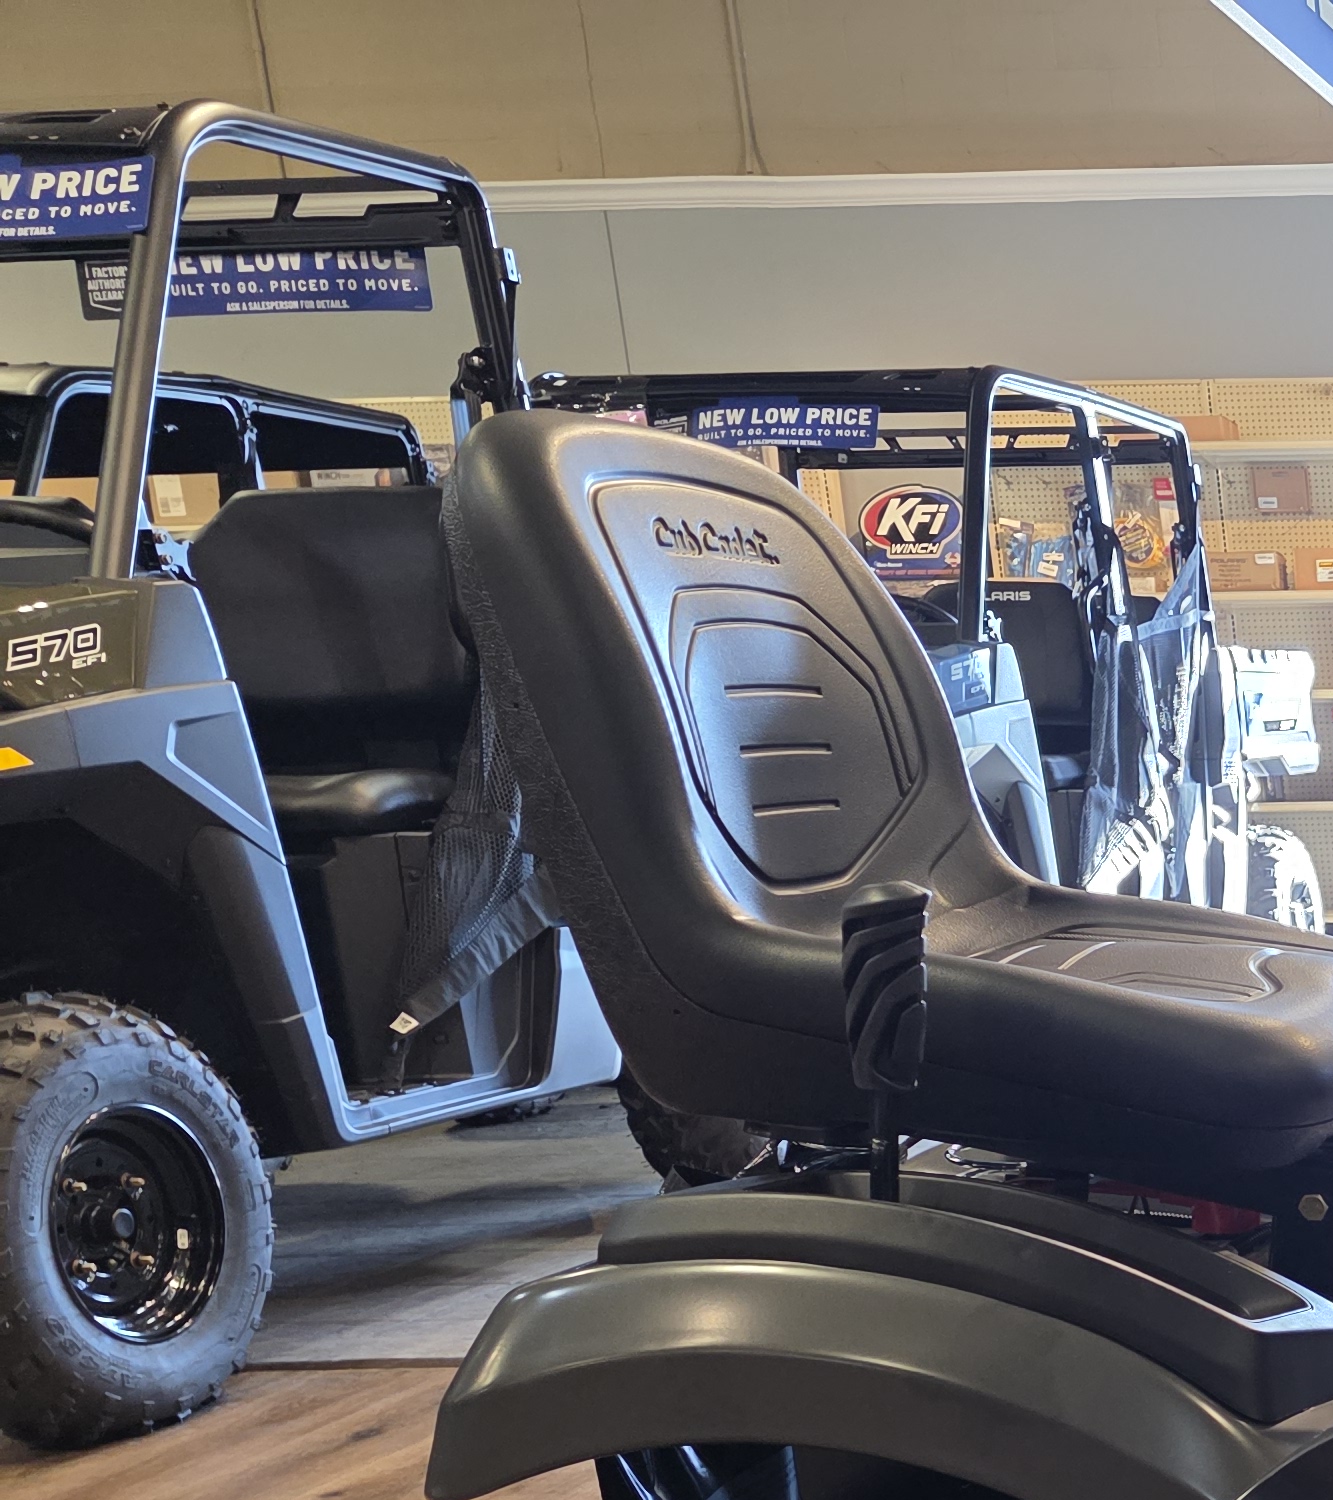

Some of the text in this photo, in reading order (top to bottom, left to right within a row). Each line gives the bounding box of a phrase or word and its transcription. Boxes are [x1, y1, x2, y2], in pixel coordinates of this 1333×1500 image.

[30, 163, 143, 200] PRICE
[1, 200, 137, 220] CED TO MOVE.
[17, 226, 56, 237] DETAILS.
[91, 265, 128, 278] FACTOR
[171, 250, 415, 275] EW LOW PRICE
[87, 278, 126, 291] AUTHORI
[171, 278, 419, 297] UILT TO GO. PRICED TO MOVE.
[93, 290, 125, 302] CLEARA
[698, 407, 873, 430] NEW LOW PRICE
[730, 428, 744, 437] TO
[747, 428, 766, 436] GO.
[770, 428, 812, 436] PRICED
[817, 428, 831, 437] TO
[835, 429, 870, 438] MOVE.
[652, 516, 702, 556] Cub
[890, 542, 940, 555] WINCH
[985, 590, 1032, 601] ARIS
[5, 622, 102, 672] 570
[71, 651, 107, 670] EFI
